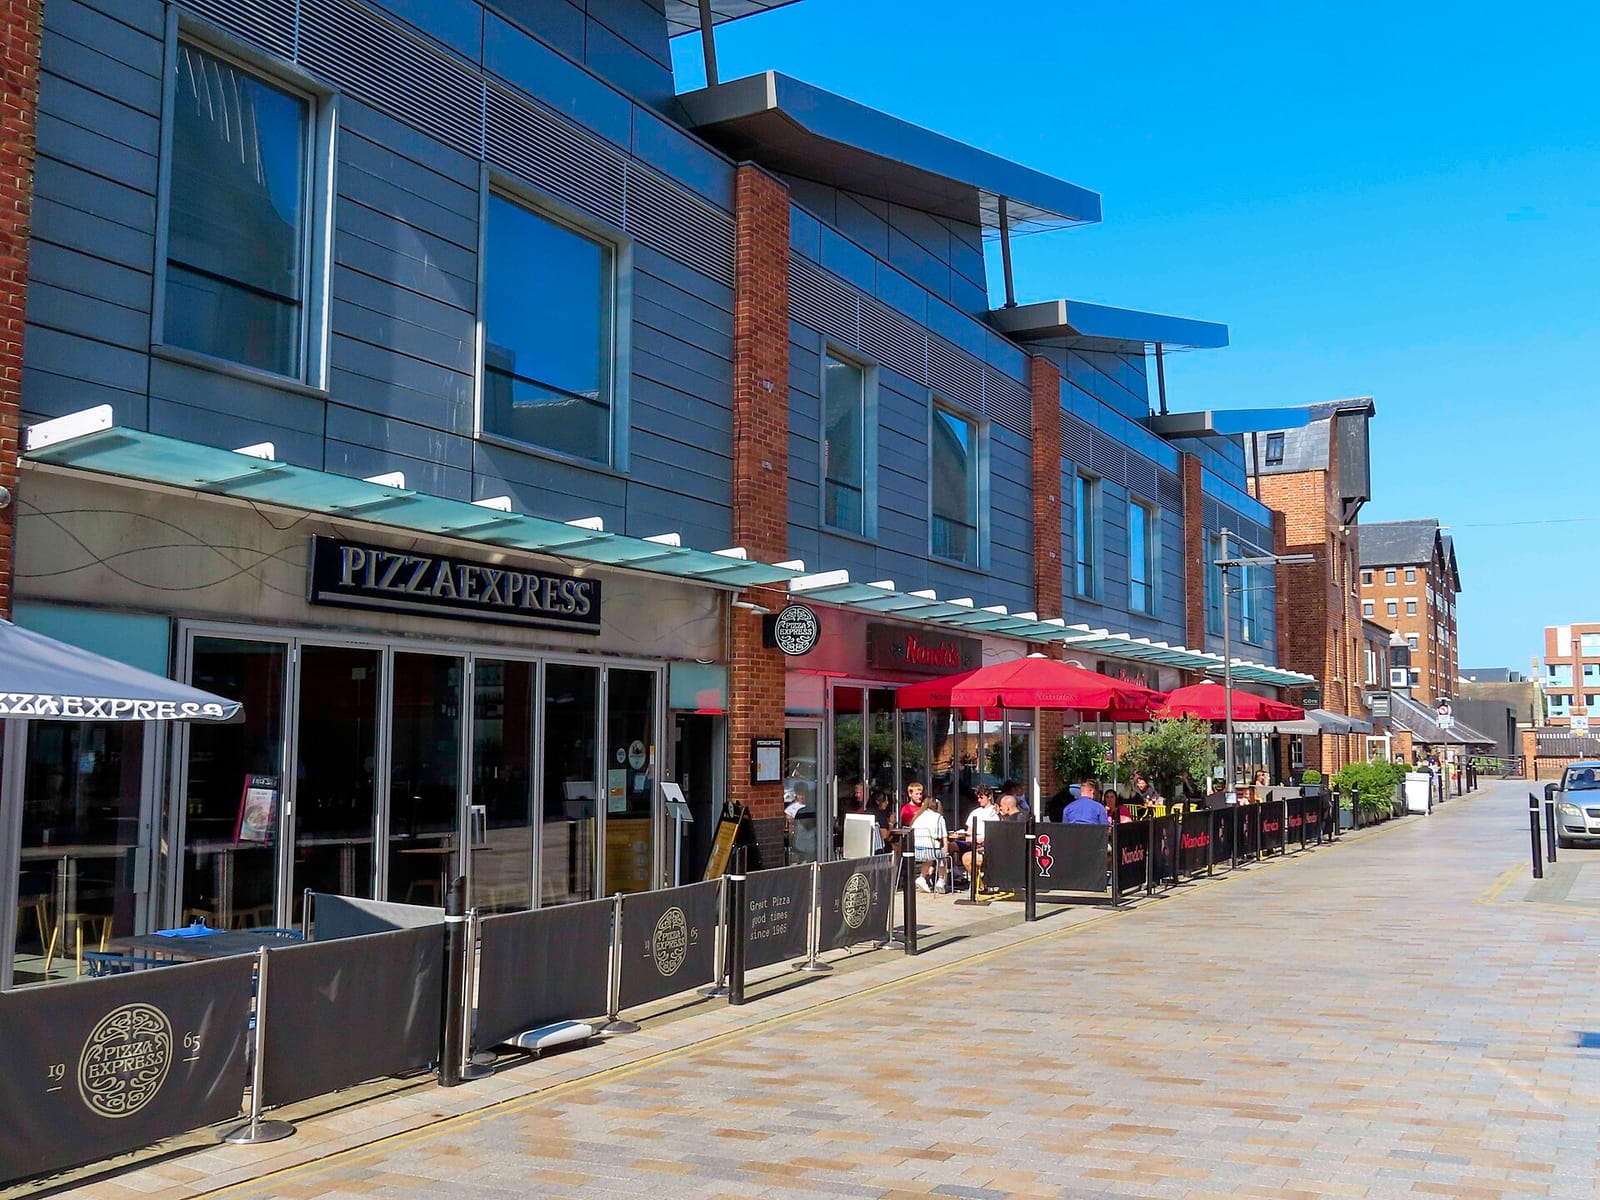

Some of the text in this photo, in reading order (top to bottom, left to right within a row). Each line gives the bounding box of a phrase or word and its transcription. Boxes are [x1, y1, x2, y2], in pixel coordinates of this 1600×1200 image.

[339, 546, 591, 616] PIZZAEXPRESS
[779, 628, 813, 636] EXPRESS
[785, 622, 807, 630] PIZZA
[905, 634, 960, 669] Nando's
[750, 896, 790, 911] Great Pizza
[771, 911, 788, 922] times
[750, 923, 787, 941] since 1965
[103, 1040, 153, 1061] PIZZA
[183, 1031, 201, 1053] 65
[88, 1050, 164, 1079] EXPRESS
